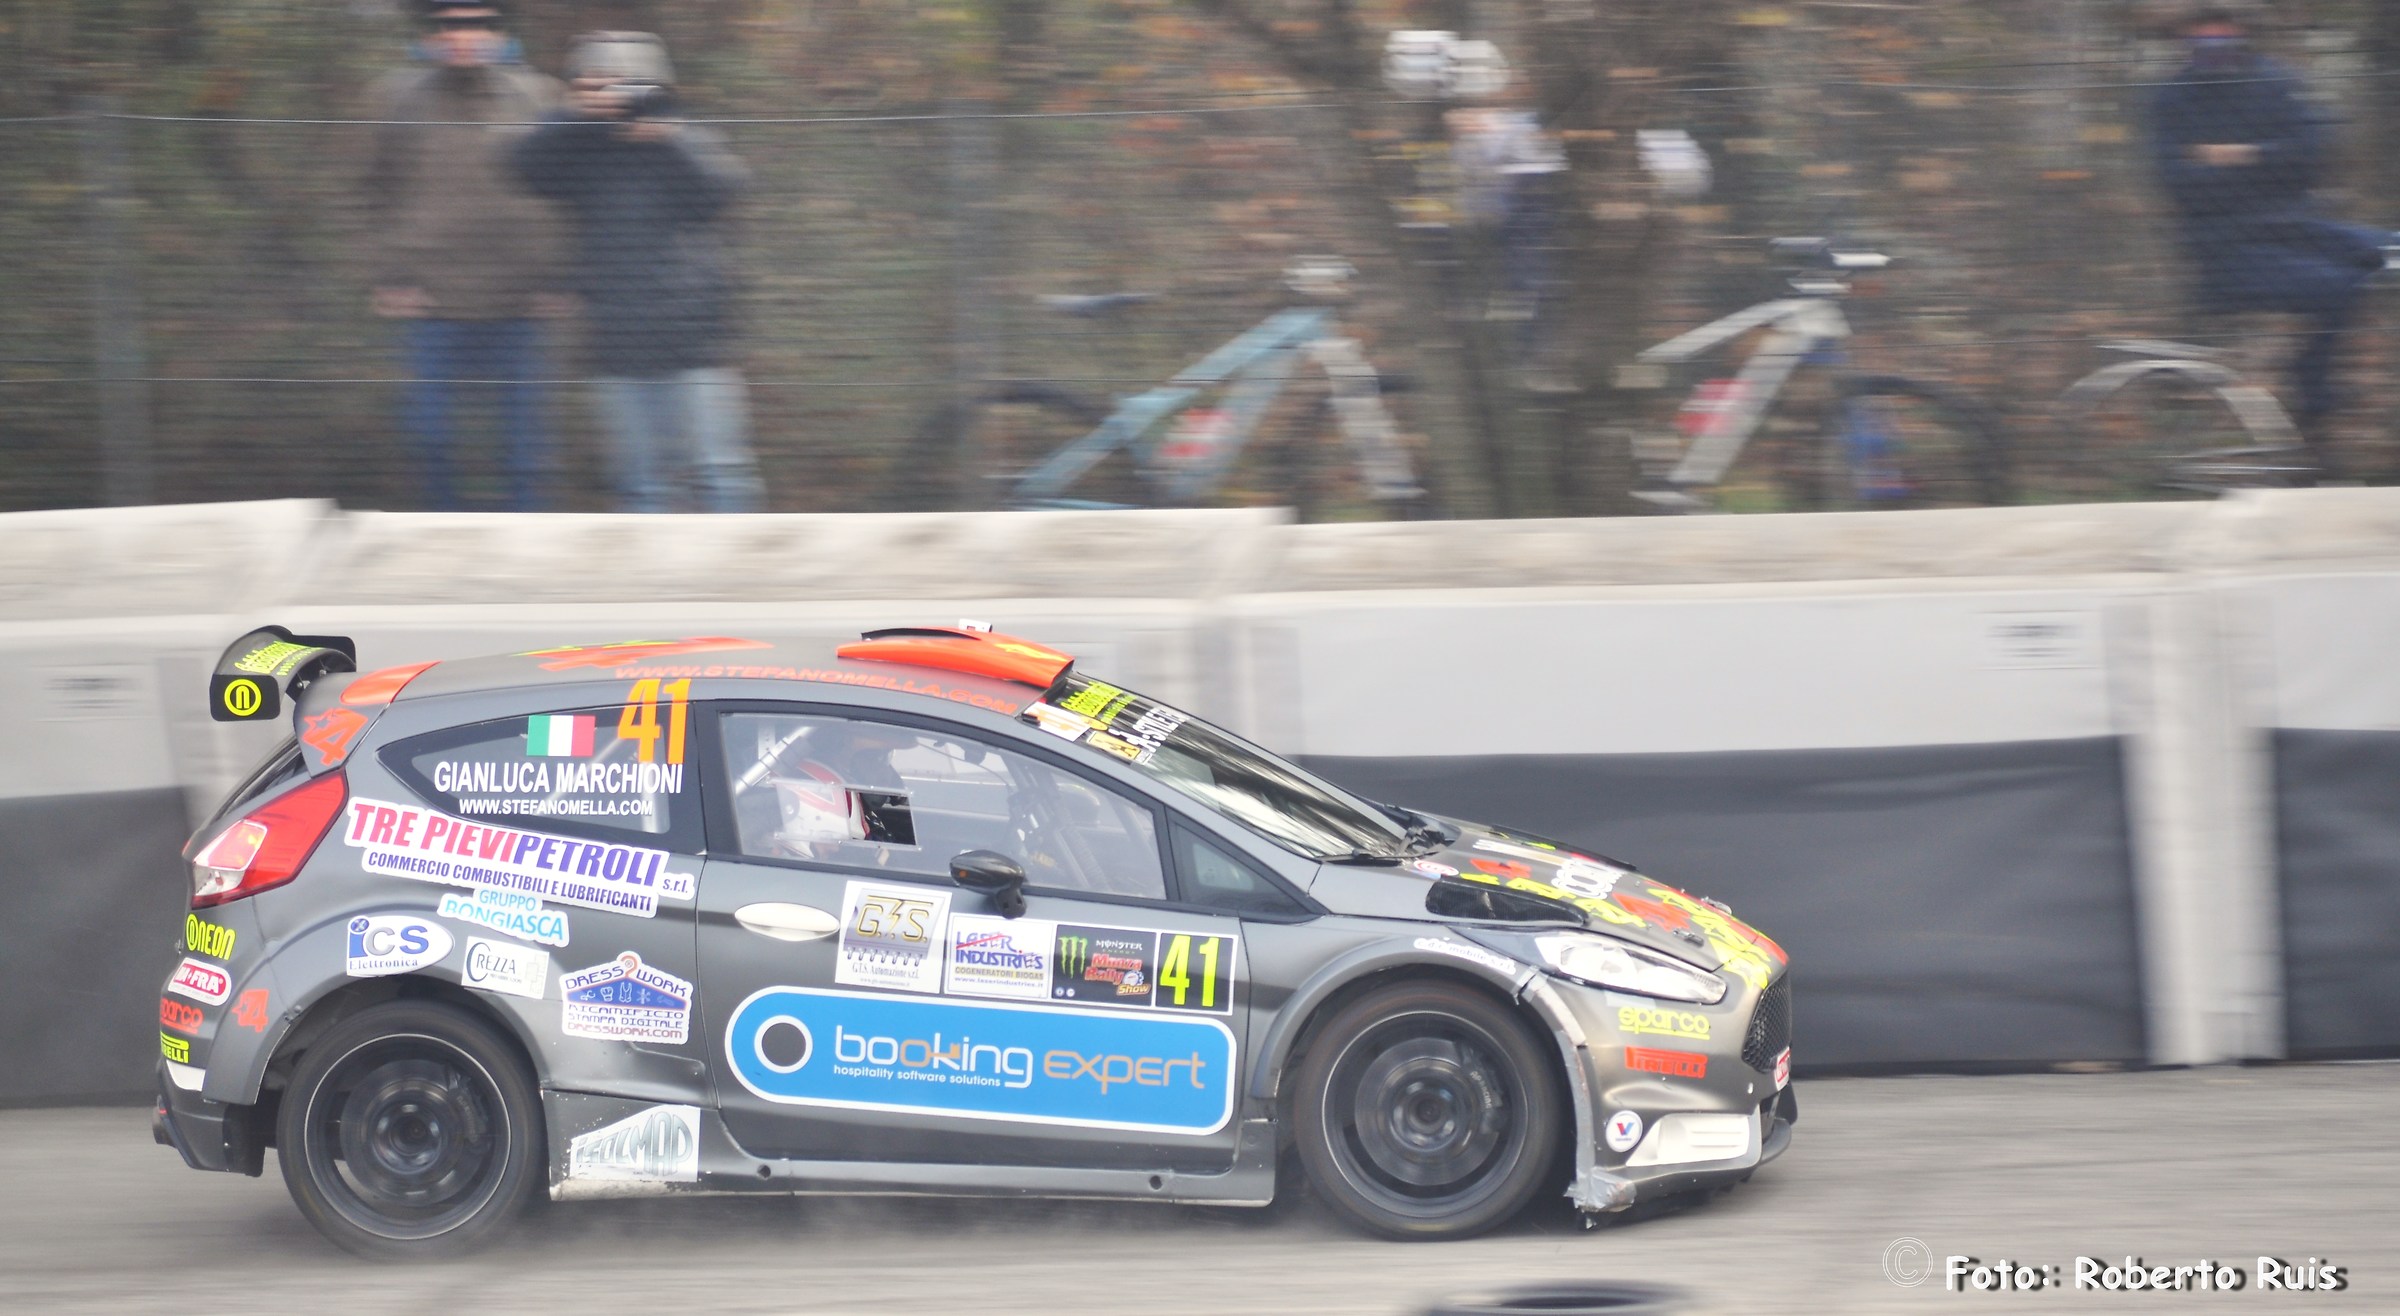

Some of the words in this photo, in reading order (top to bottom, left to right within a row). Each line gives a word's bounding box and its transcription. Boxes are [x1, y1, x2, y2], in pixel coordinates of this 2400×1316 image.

[617, 678, 692, 765] 41
[434, 761, 550, 793] GIANLUCA
[556, 763, 683, 794] MARCHIONI
[459, 799, 652, 817] WWW.STEFANOMELLA.COM
[351, 803, 418, 847] TRE
[662, 878, 689, 894] s.r.l.
[368, 852, 450, 878] COMMERCIO
[452, 864, 549, 895] COMBUSTIBILI
[550, 880, 559, 896] E
[561, 883, 652, 912] LUBRIFICANTI
[479, 889, 536, 911] GRUPPO
[956, 930, 1017, 953] LASER
[1095, 939, 1143, 951] MONSTER
[349, 957, 418, 970] Elettronica
[466, 942, 516, 983] CREZZA
[955, 949, 1044, 970] INDUSTRIES
[1160, 934, 1221, 1007] 41
[565, 966, 624, 990] DRESS
[636, 969, 687, 997] WORK
[955, 967, 1014, 979] COGENERATORI
[1015, 972, 1044, 981] BIOGAS
[1085, 966, 1125, 986] Rally
[1118, 984, 1150, 995] Show
[568, 1004, 684, 1019] RICAMIFICIO
[568, 1012, 616, 1024] STAMPA
[621, 1017, 683, 1029] DIGITALE
[1618, 1006, 1710, 1036] sparco
[835, 1025, 1033, 1089] booking
[1044, 1050, 1207, 1095] expert
[1625, 1044, 1708, 1079] PIRELLI
[834, 1065, 893, 1081] hospitality
[897, 1071, 946, 1083] software
[949, 1074, 1001, 1087] solutions
